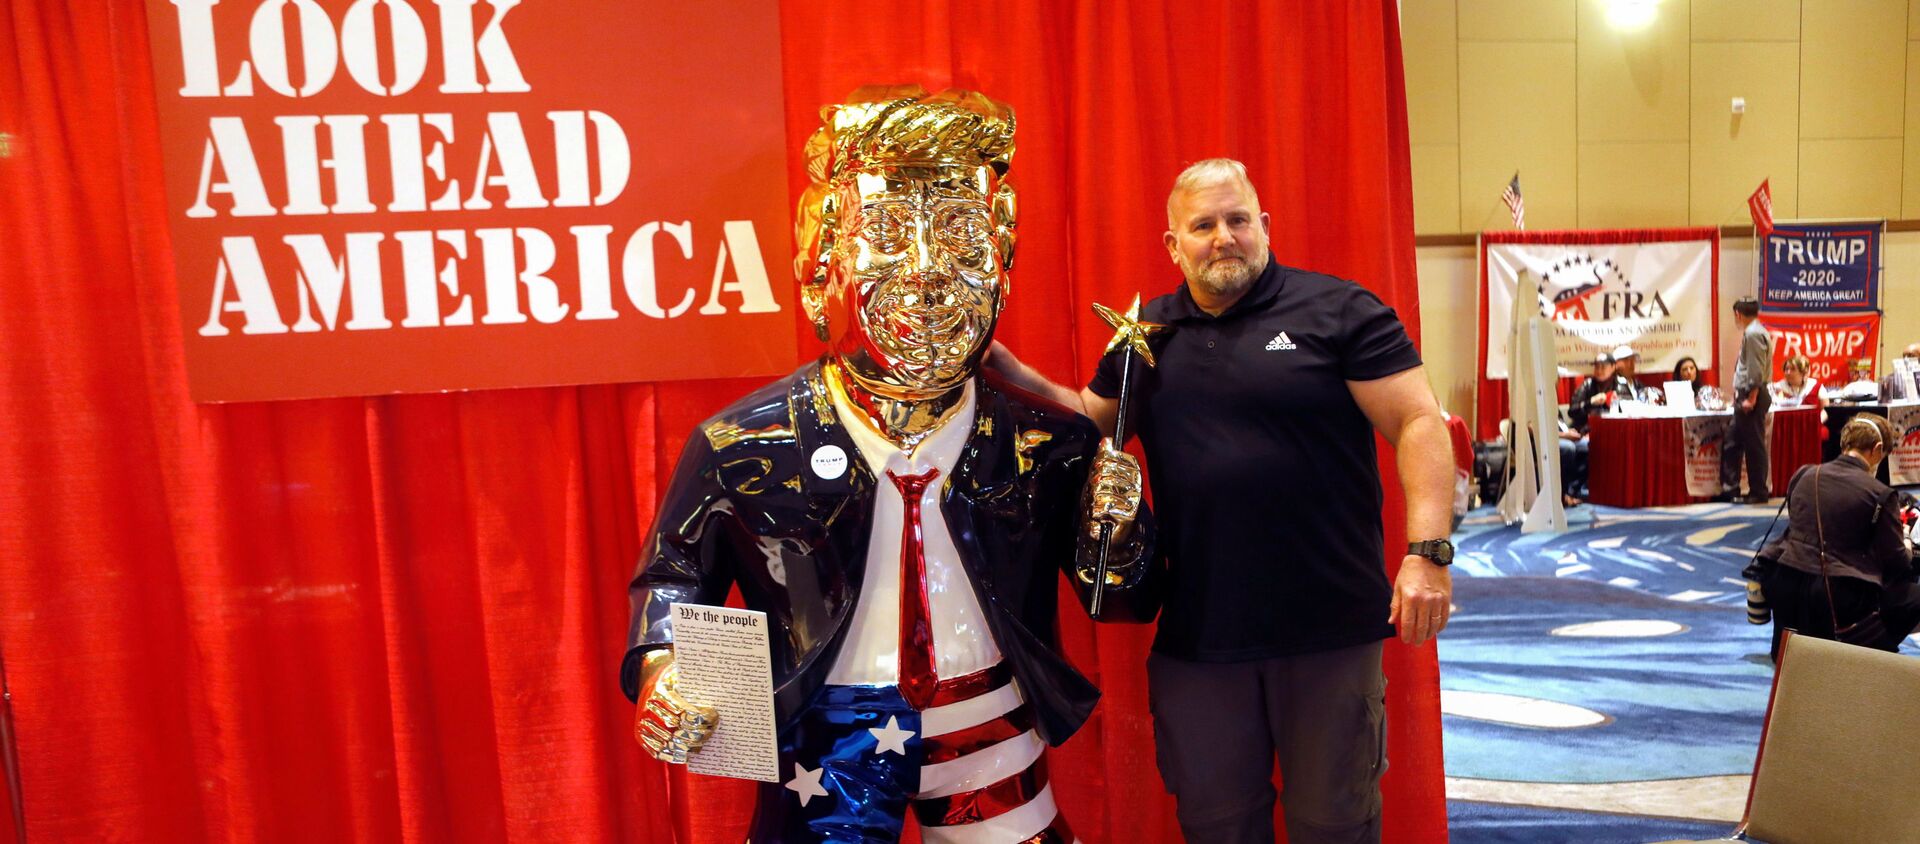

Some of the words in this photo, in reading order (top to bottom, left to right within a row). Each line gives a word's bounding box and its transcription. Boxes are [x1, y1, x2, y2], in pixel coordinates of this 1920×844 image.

[169, 0, 531, 97] LOOK
[186, 110, 632, 218] AHEAD
[1770, 237, 1866, 265] TRUMP
[198, 220, 781, 336] AMERICA
[1603, 290, 1670, 320] FRA
[1768, 289, 1793, 300] KEEP
[1793, 290, 1832, 301] AMERICA
[1832, 290, 1864, 300] GREAT!
[1265, 343, 1297, 351] adidas
[1770, 330, 1864, 358] TRUMP
[679, 607, 700, 621] We
[703, 611, 719, 624] the
[722, 615, 758, 627] people
